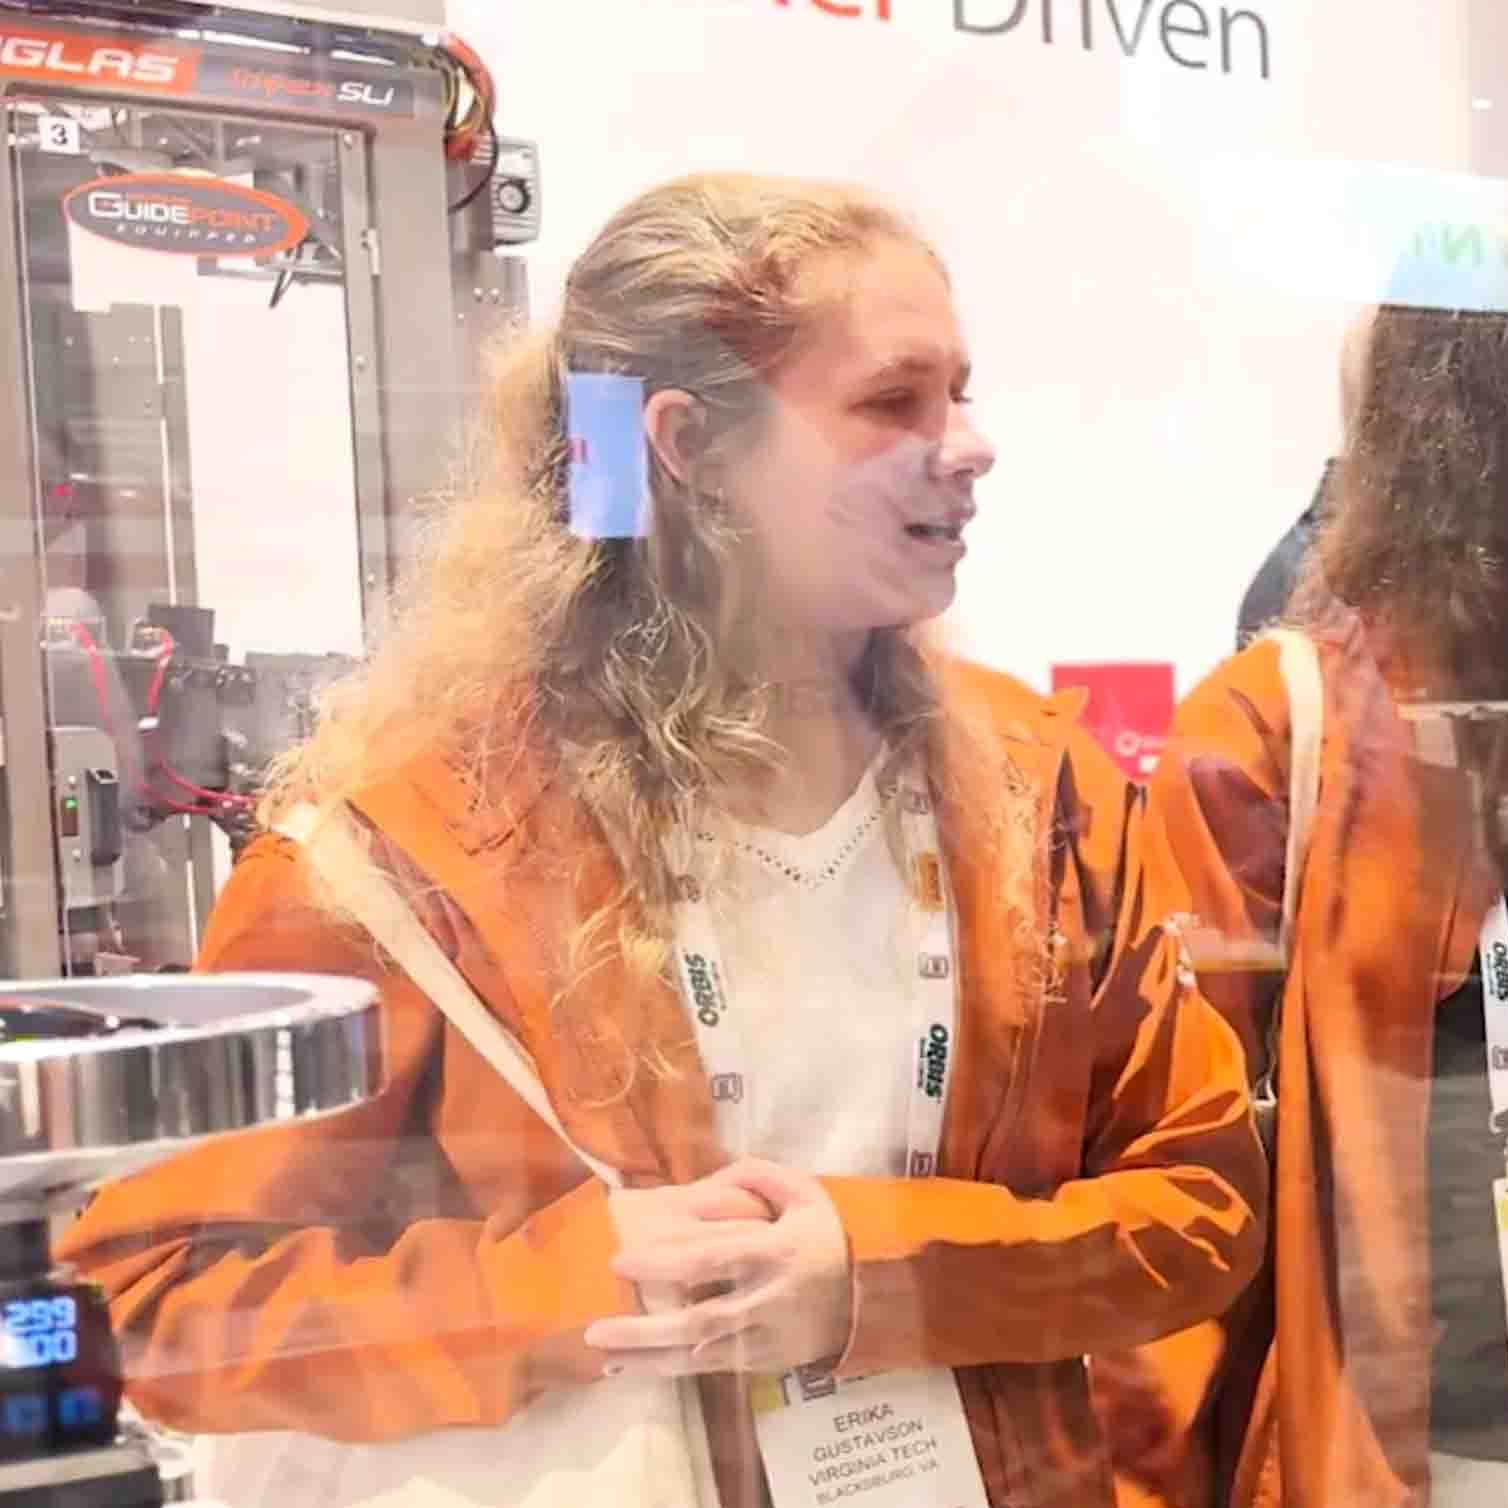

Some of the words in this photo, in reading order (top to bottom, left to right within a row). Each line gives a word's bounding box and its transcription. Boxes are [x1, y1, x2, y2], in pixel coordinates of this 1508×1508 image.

[0, 35, 179, 83] GLAS
[50, 124, 69, 147] 3
[812, 1417, 925, 1463] GUSTAVSON
[832, 1402, 895, 1433] ERIKA
[807, 1453, 888, 1487] VIRGINIA
[891, 1436, 938, 1461] TECH
